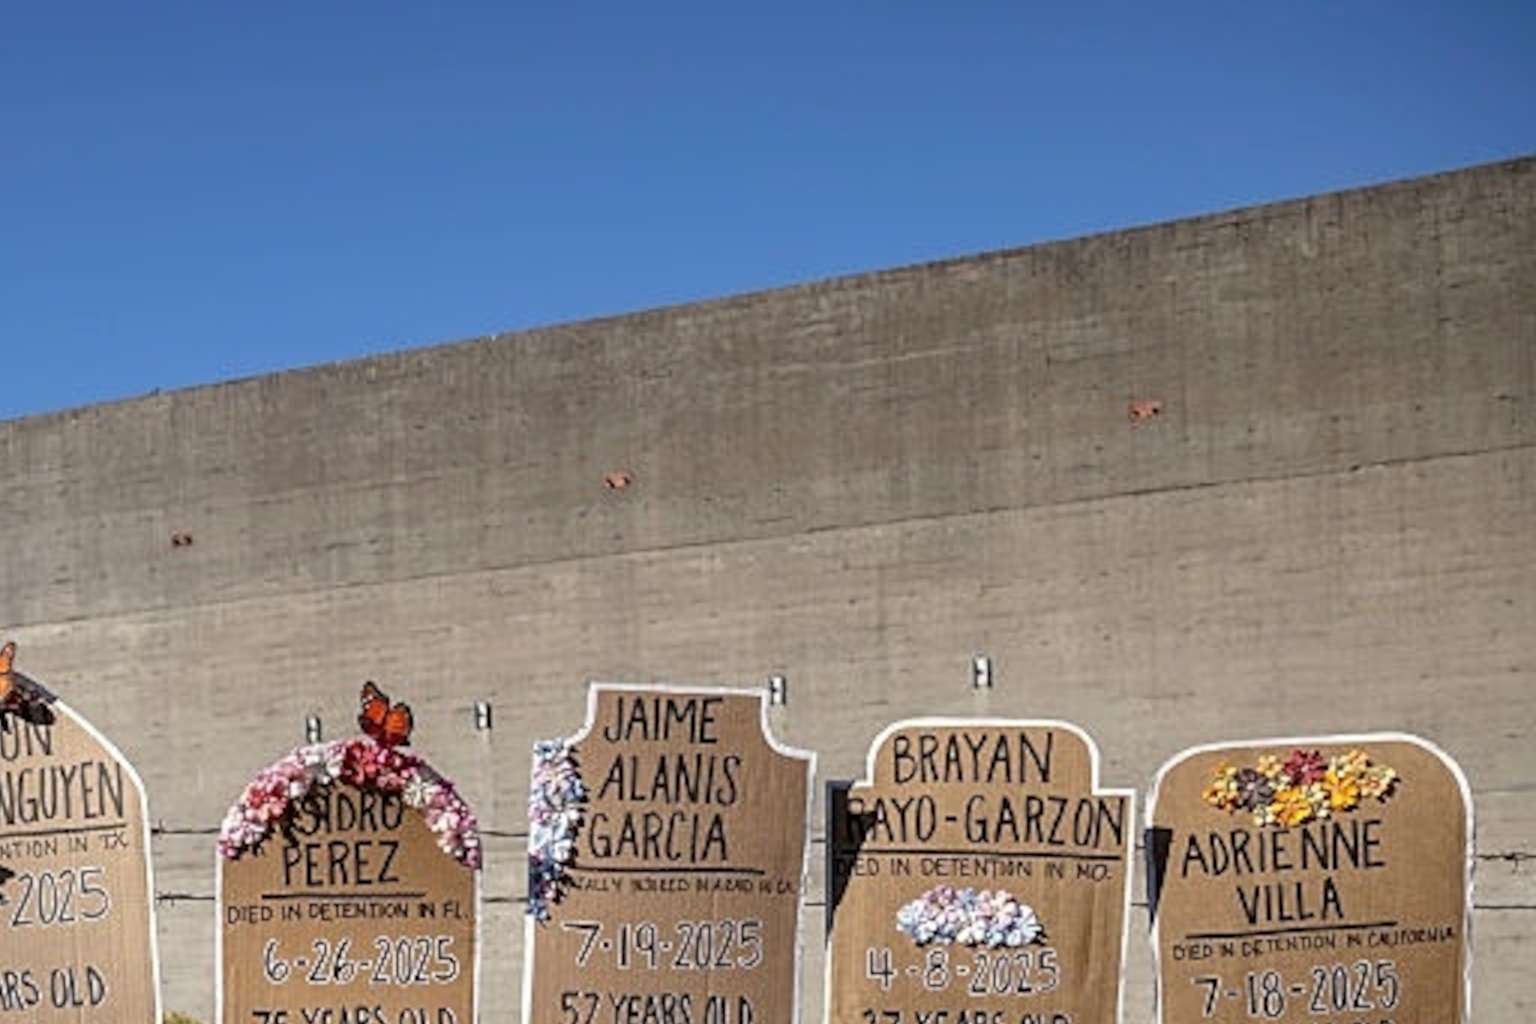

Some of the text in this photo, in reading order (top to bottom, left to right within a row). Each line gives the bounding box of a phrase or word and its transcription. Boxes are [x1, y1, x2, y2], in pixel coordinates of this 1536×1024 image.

[604, 696, 723, 744] JAIME
[599, 753, 742, 807] ALANIS
[894, 732, 1053, 784] BRAYAN
[291, 790, 402, 836] SIDRO
[68, 837, 87, 852] IN
[100, 833, 129, 848] TX
[588, 810, 728, 863] GARCIA
[1182, 820, 1386, 878] ADRIENNE
[284, 841, 399, 885] PEREZ
[572, 877, 621, 893] TALLY
[891, 858, 911, 876] IN
[922, 858, 1032, 878] DETENTION
[1047, 862, 1063, 879] IN
[228, 905, 273, 925] DIED
[282, 903, 301, 921] IN
[309, 902, 408, 921] DETENTION
[420, 903, 435, 919] IN
[1237, 877, 1344, 924] VILLA
[265, 938, 458, 984] 6-26-2025
[564, 921, 761, 968] 7-19-2025
[1173, 944, 1213, 961] DIED
[1221, 942, 1235, 957] IN
[1242, 935, 1336, 957] DETENTION
[1348, 936, 1362, 950] IN
[50, 966, 106, 1008] OLD
[869, 951, 1058, 994] 4-8-2025
[1195, 962, 1399, 1017] 7-18-2025
